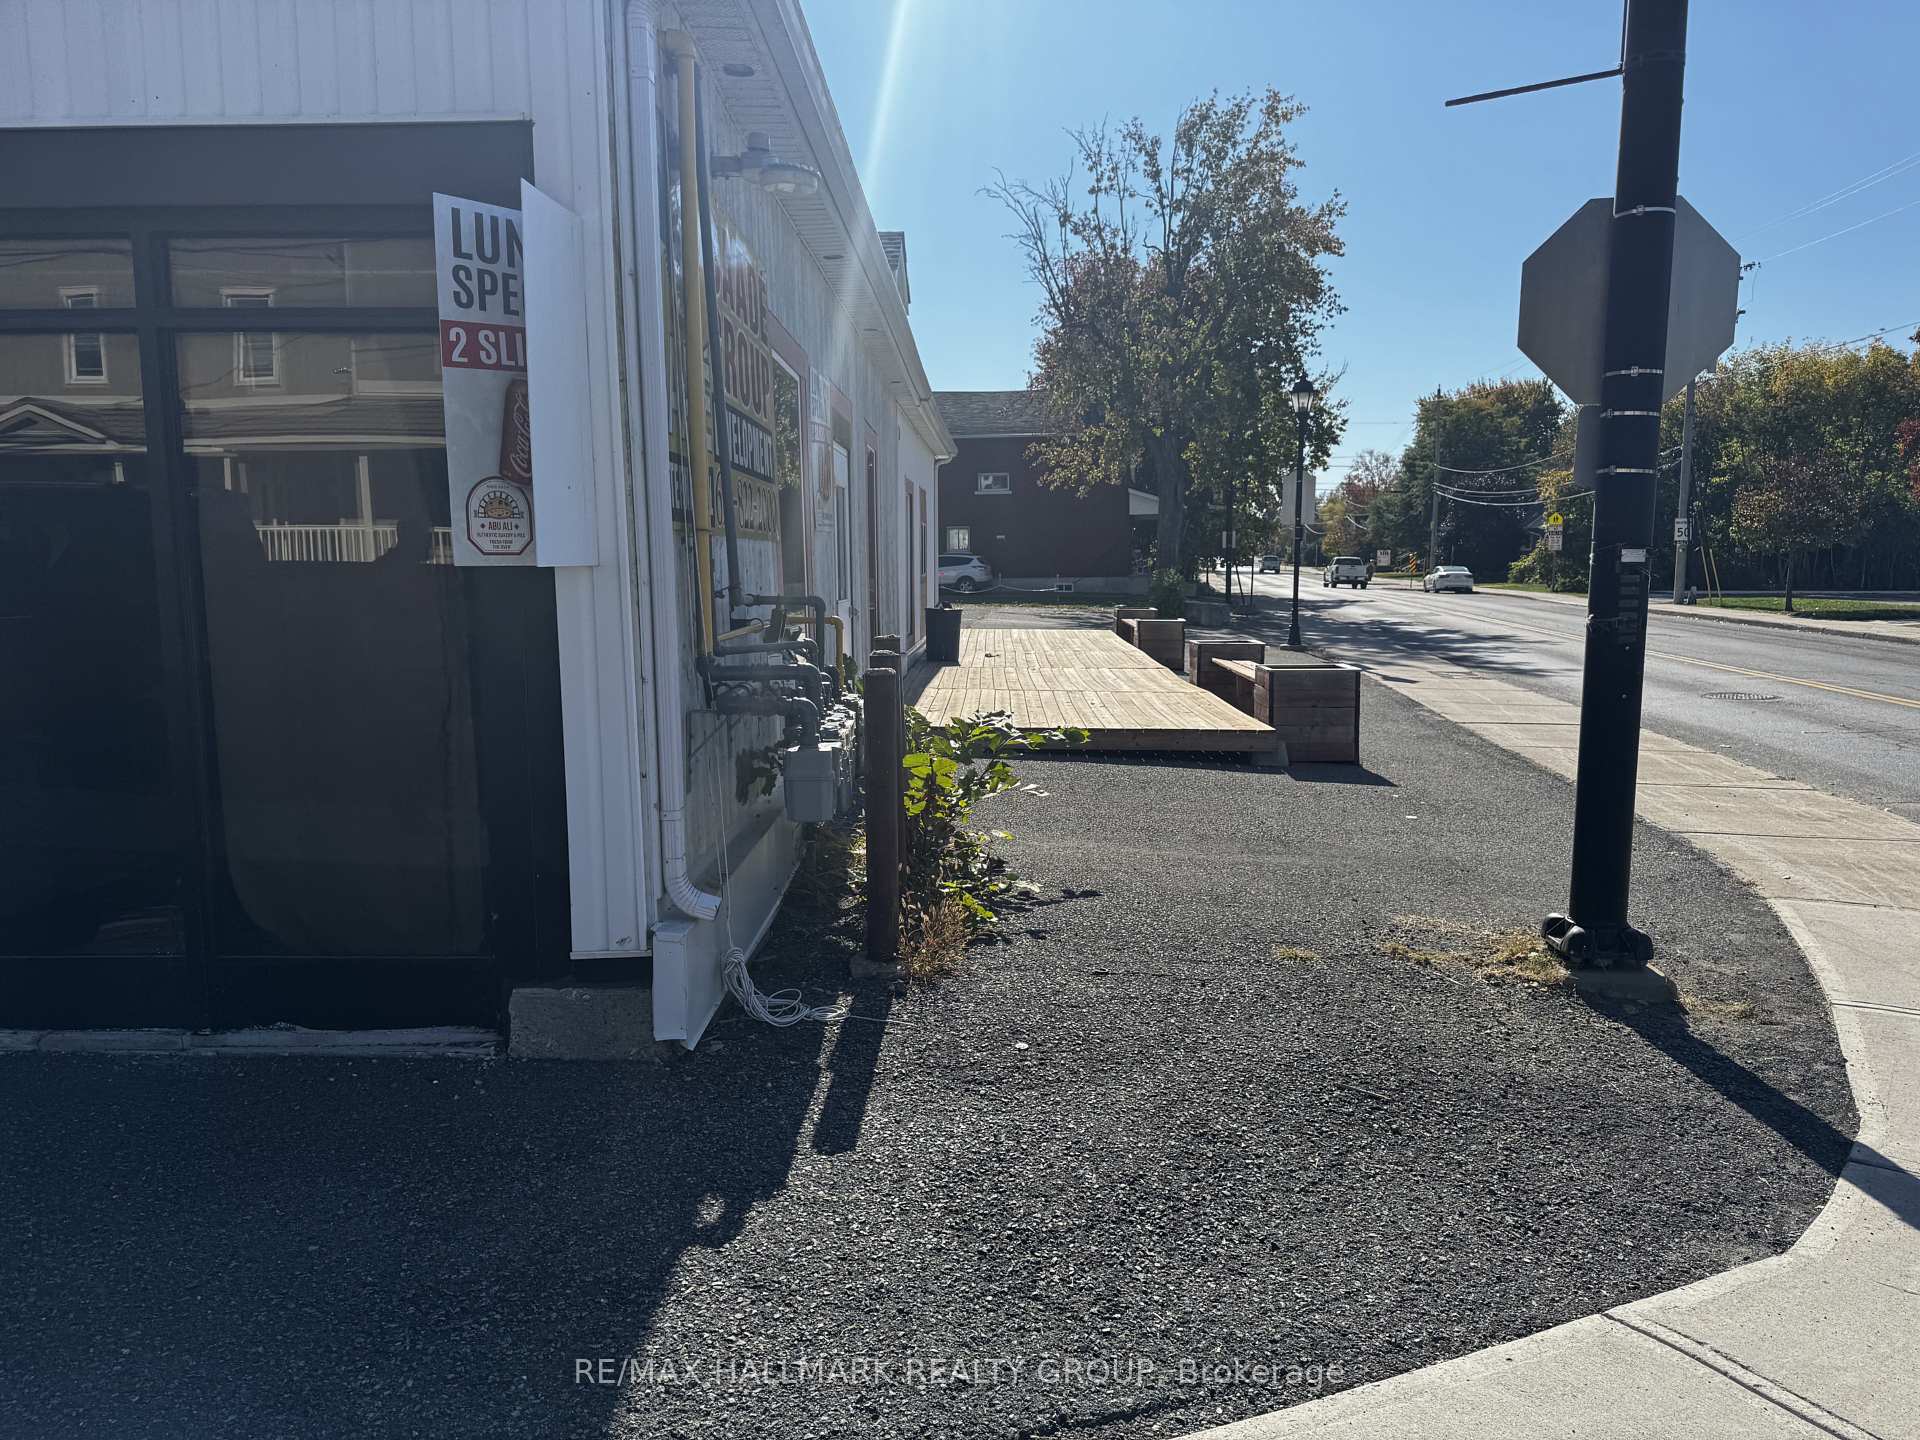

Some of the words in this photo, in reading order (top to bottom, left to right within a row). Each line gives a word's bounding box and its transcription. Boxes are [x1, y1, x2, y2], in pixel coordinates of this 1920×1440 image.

[452, 265, 524, 316] SPE
[449, 327, 468, 362] 2
[479, 329, 525, 367] SLI
[718, 312, 770, 420] ROUP
[714, 401, 774, 480] VELOPMENT
[489, 521, 501, 531] ABU
[503, 522, 513, 531] ALI
